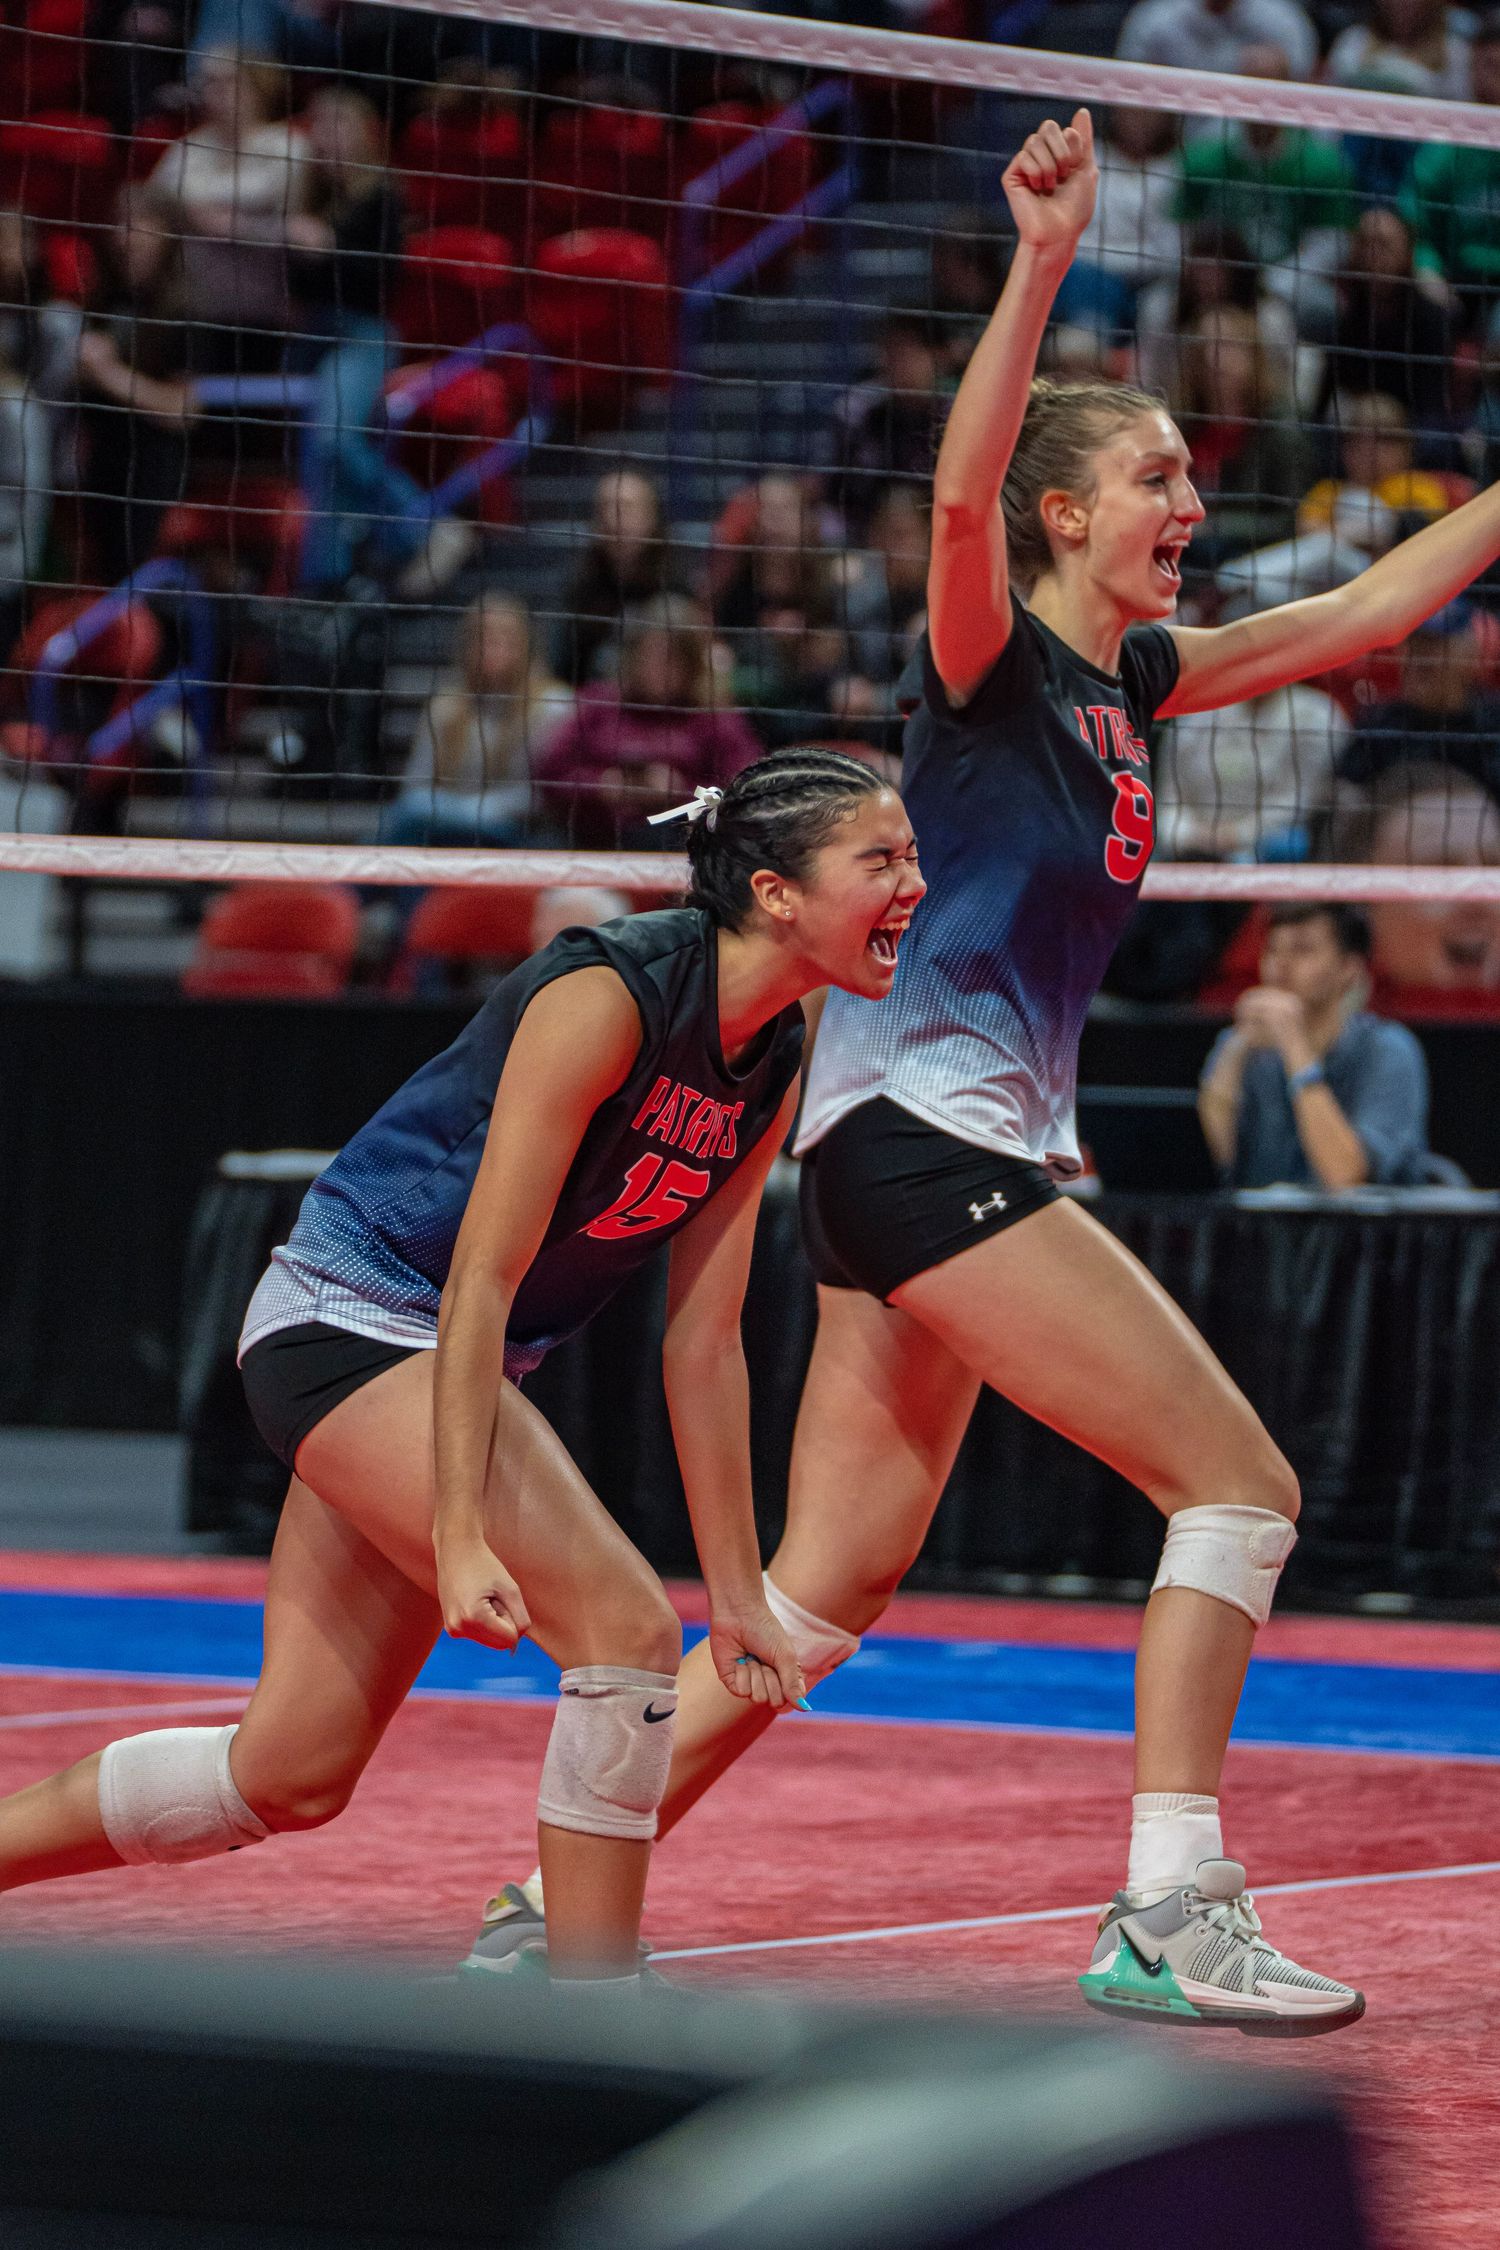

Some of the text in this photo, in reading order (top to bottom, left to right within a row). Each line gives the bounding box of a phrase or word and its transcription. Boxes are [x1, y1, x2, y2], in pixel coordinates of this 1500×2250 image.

[1105, 770, 1154, 884] 9
[631, 1075, 745, 1159] PATRS
[577, 1152, 710, 1240] 15
